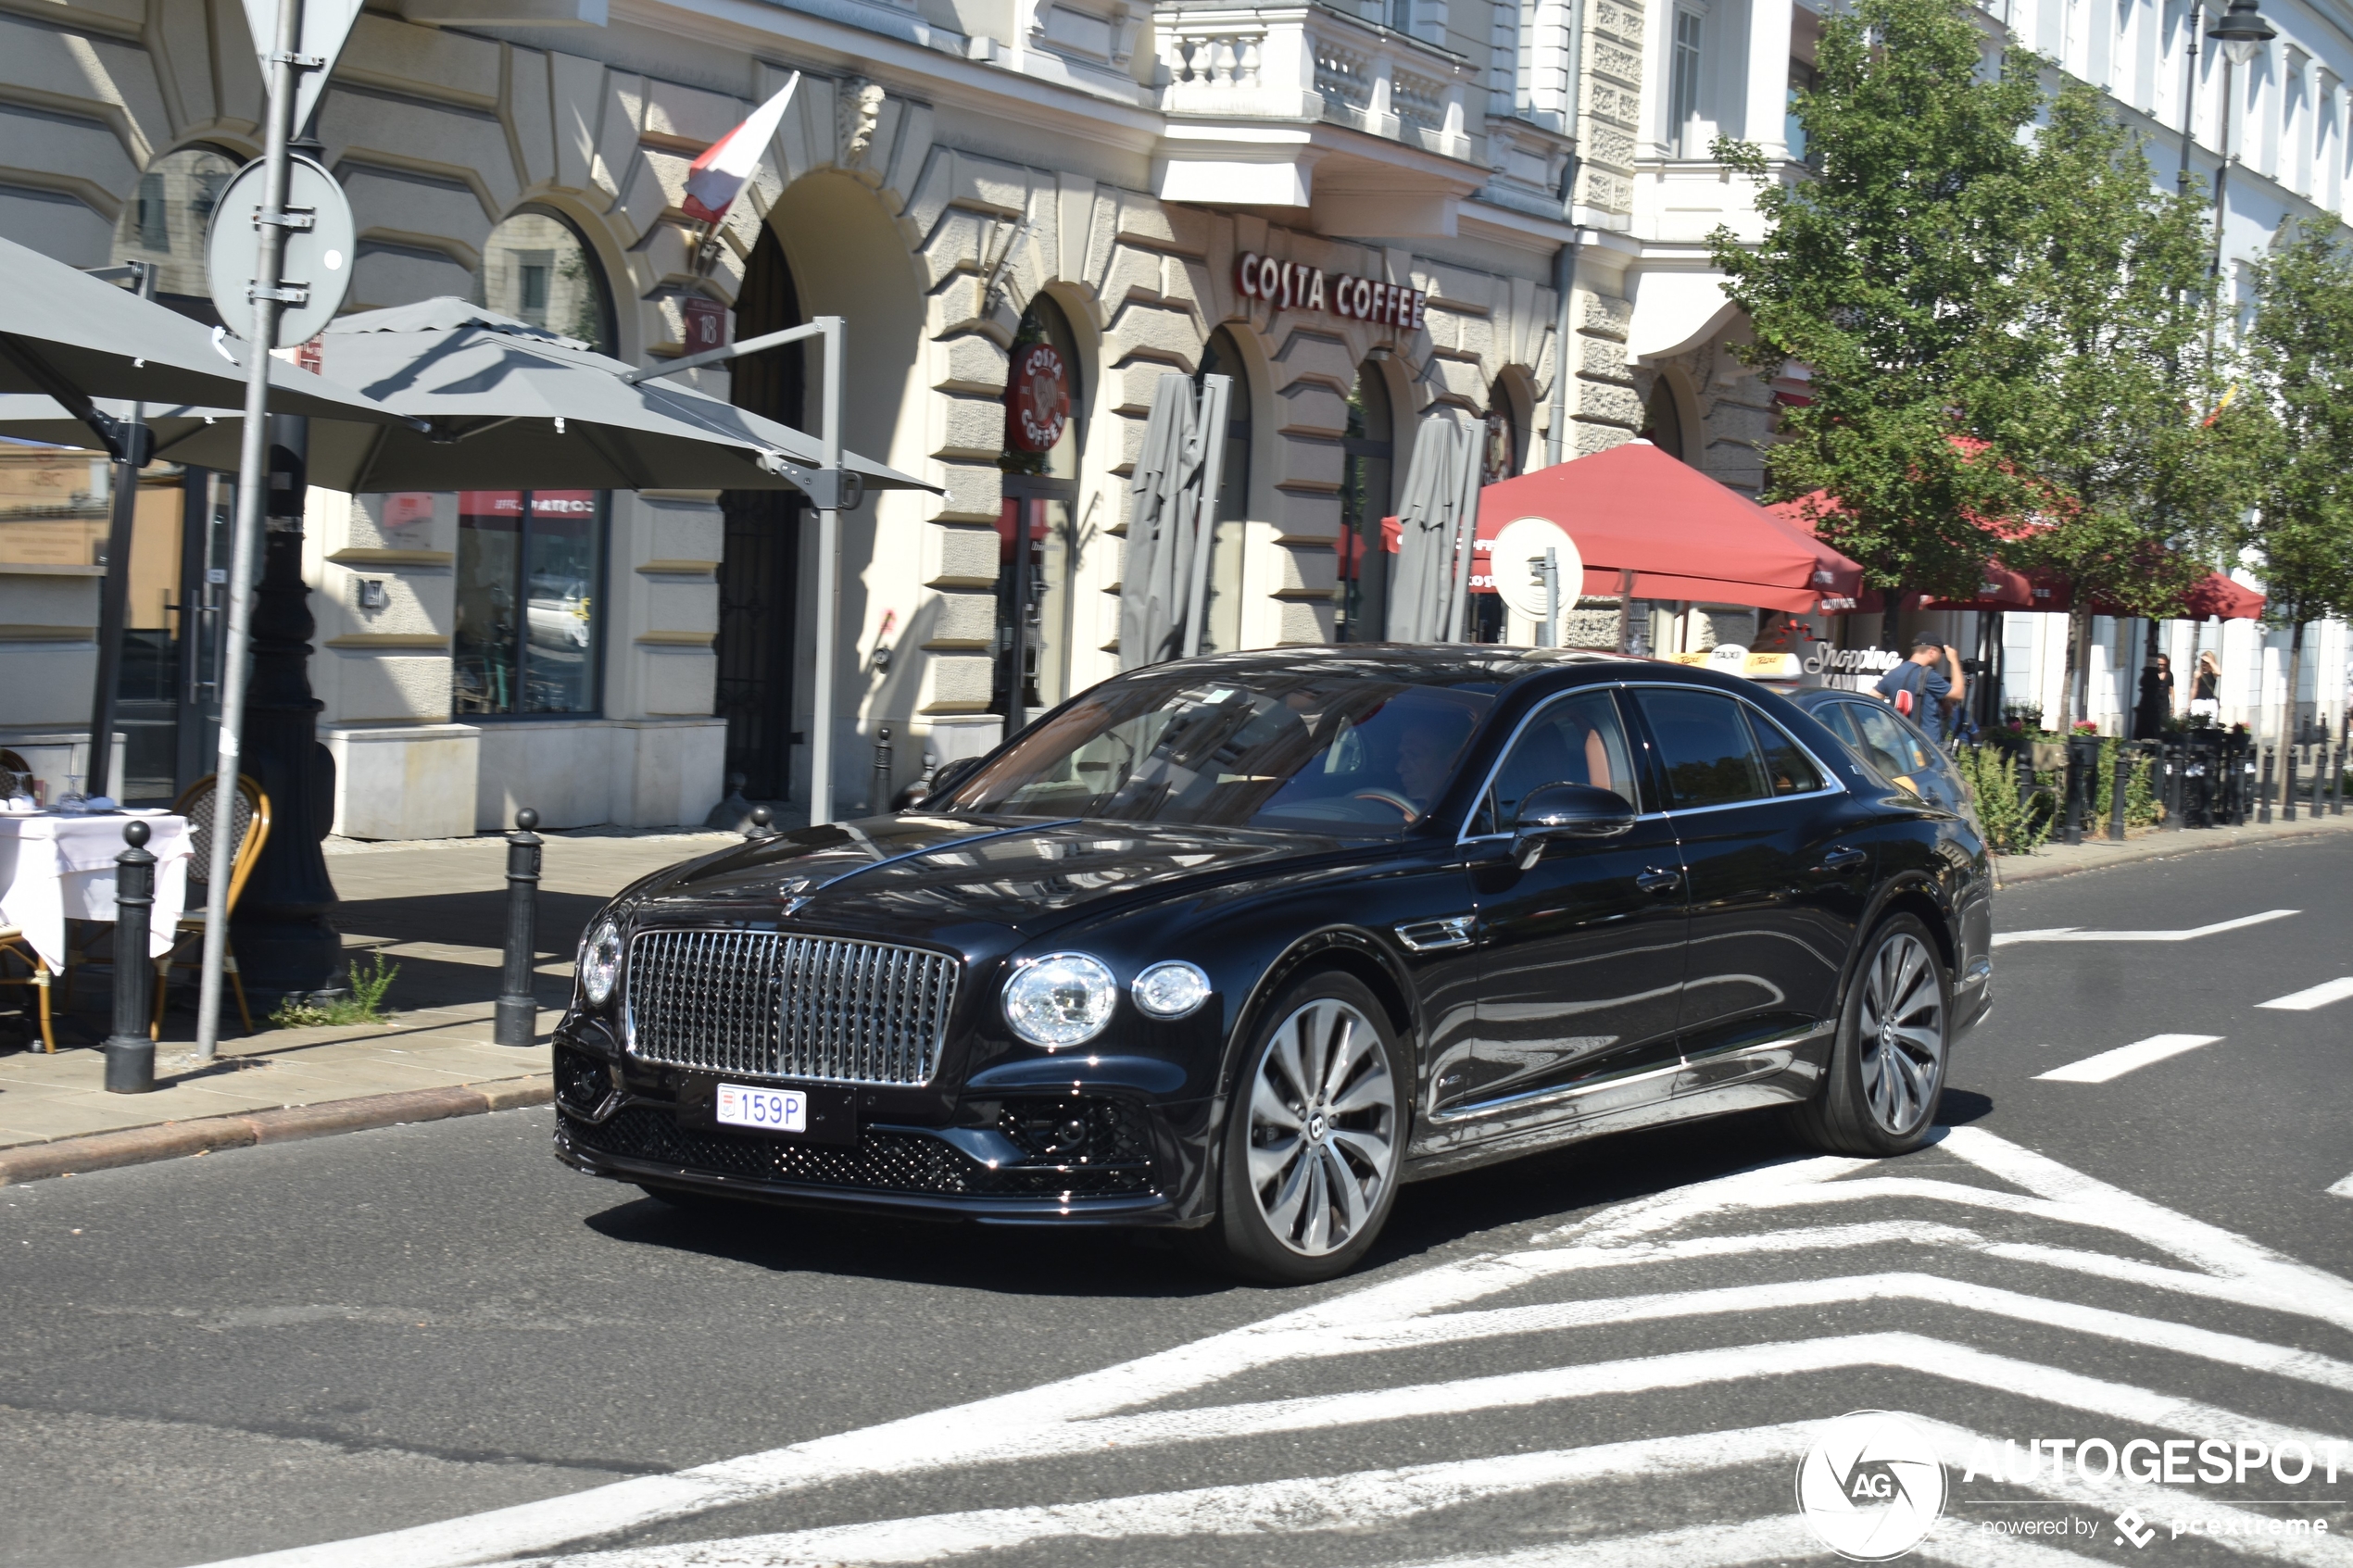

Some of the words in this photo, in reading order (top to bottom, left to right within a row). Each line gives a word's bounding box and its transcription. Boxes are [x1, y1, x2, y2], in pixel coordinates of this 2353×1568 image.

[1238, 252, 1325, 311] COSTA
[1333, 273, 1425, 330] COFFEE
[698, 315, 717, 344] 18
[1025, 348, 1063, 381] COSTA
[1021, 408, 1064, 446] COFFEE
[1714, 650, 1741, 659] TAXI
[1804, 642, 1903, 675] Shopping
[742, 1093, 799, 1124] 159P
